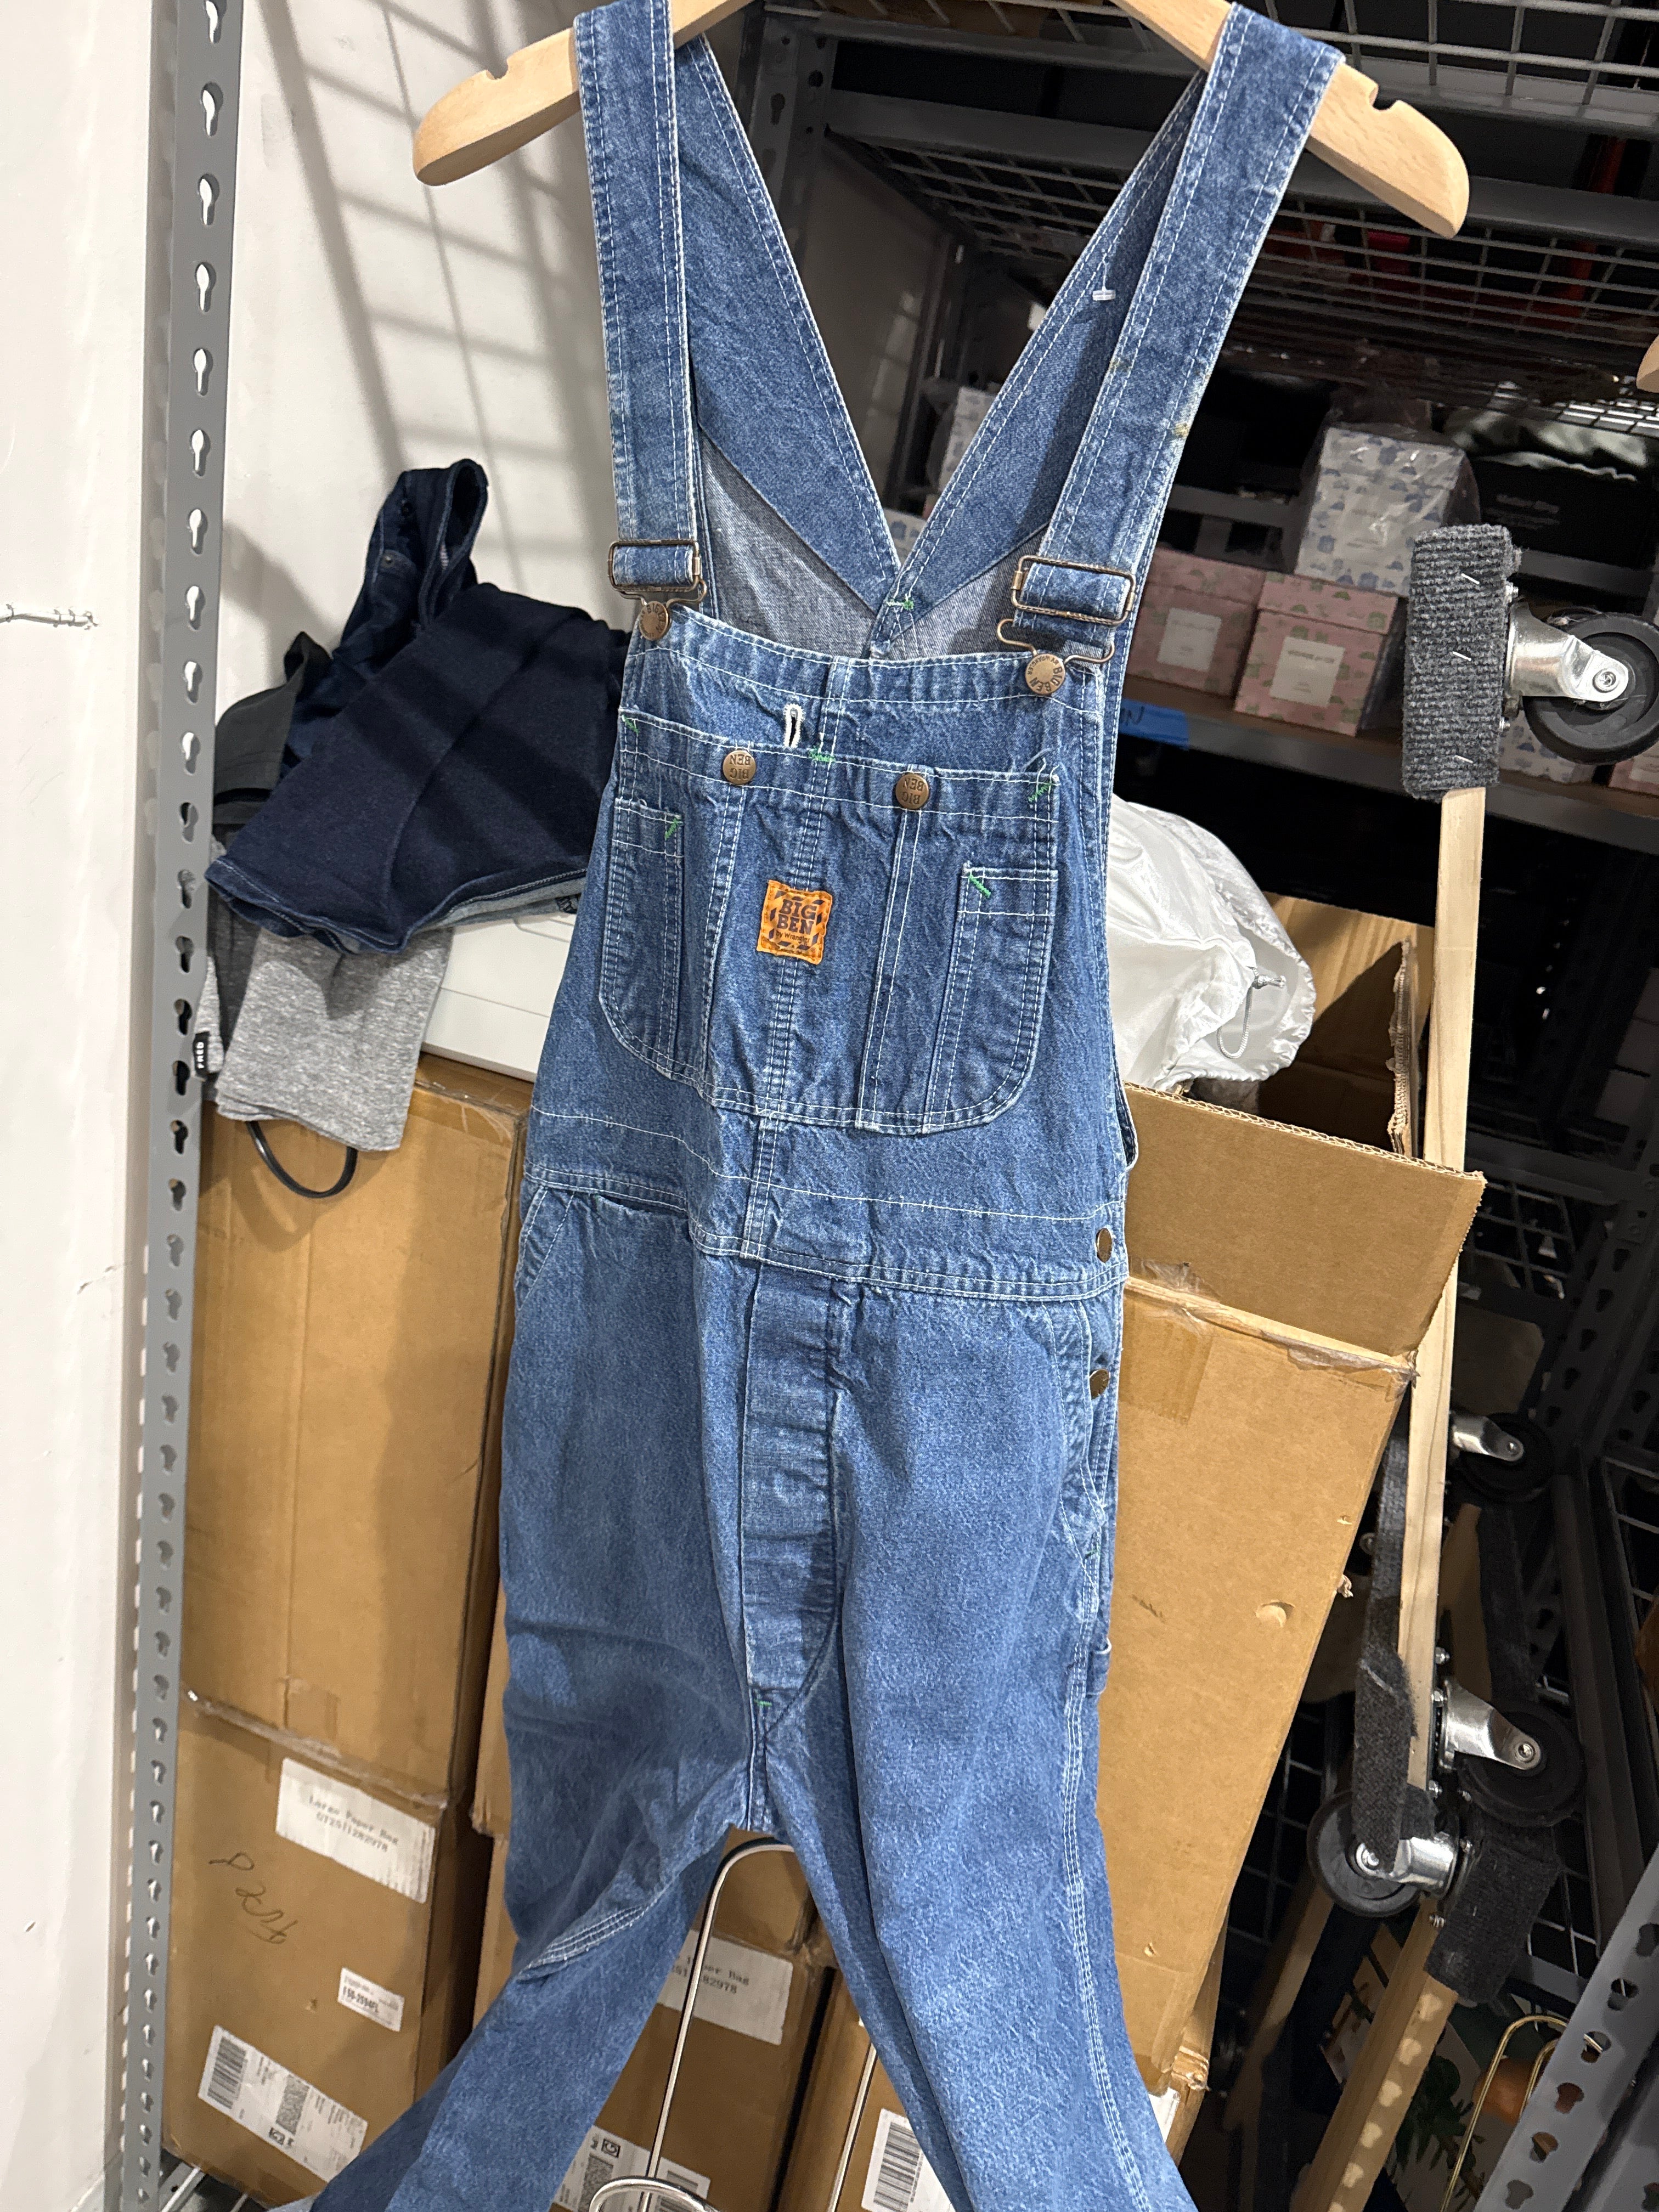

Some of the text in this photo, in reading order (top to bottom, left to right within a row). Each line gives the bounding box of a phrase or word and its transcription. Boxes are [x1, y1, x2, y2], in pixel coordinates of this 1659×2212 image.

[730, 754, 751, 766] BEN
[730, 768, 749, 779] BIG
[779, 899, 817, 920] BIG
[777, 914, 814, 935] BEN
[776, 929, 810, 944] by Wrangler
